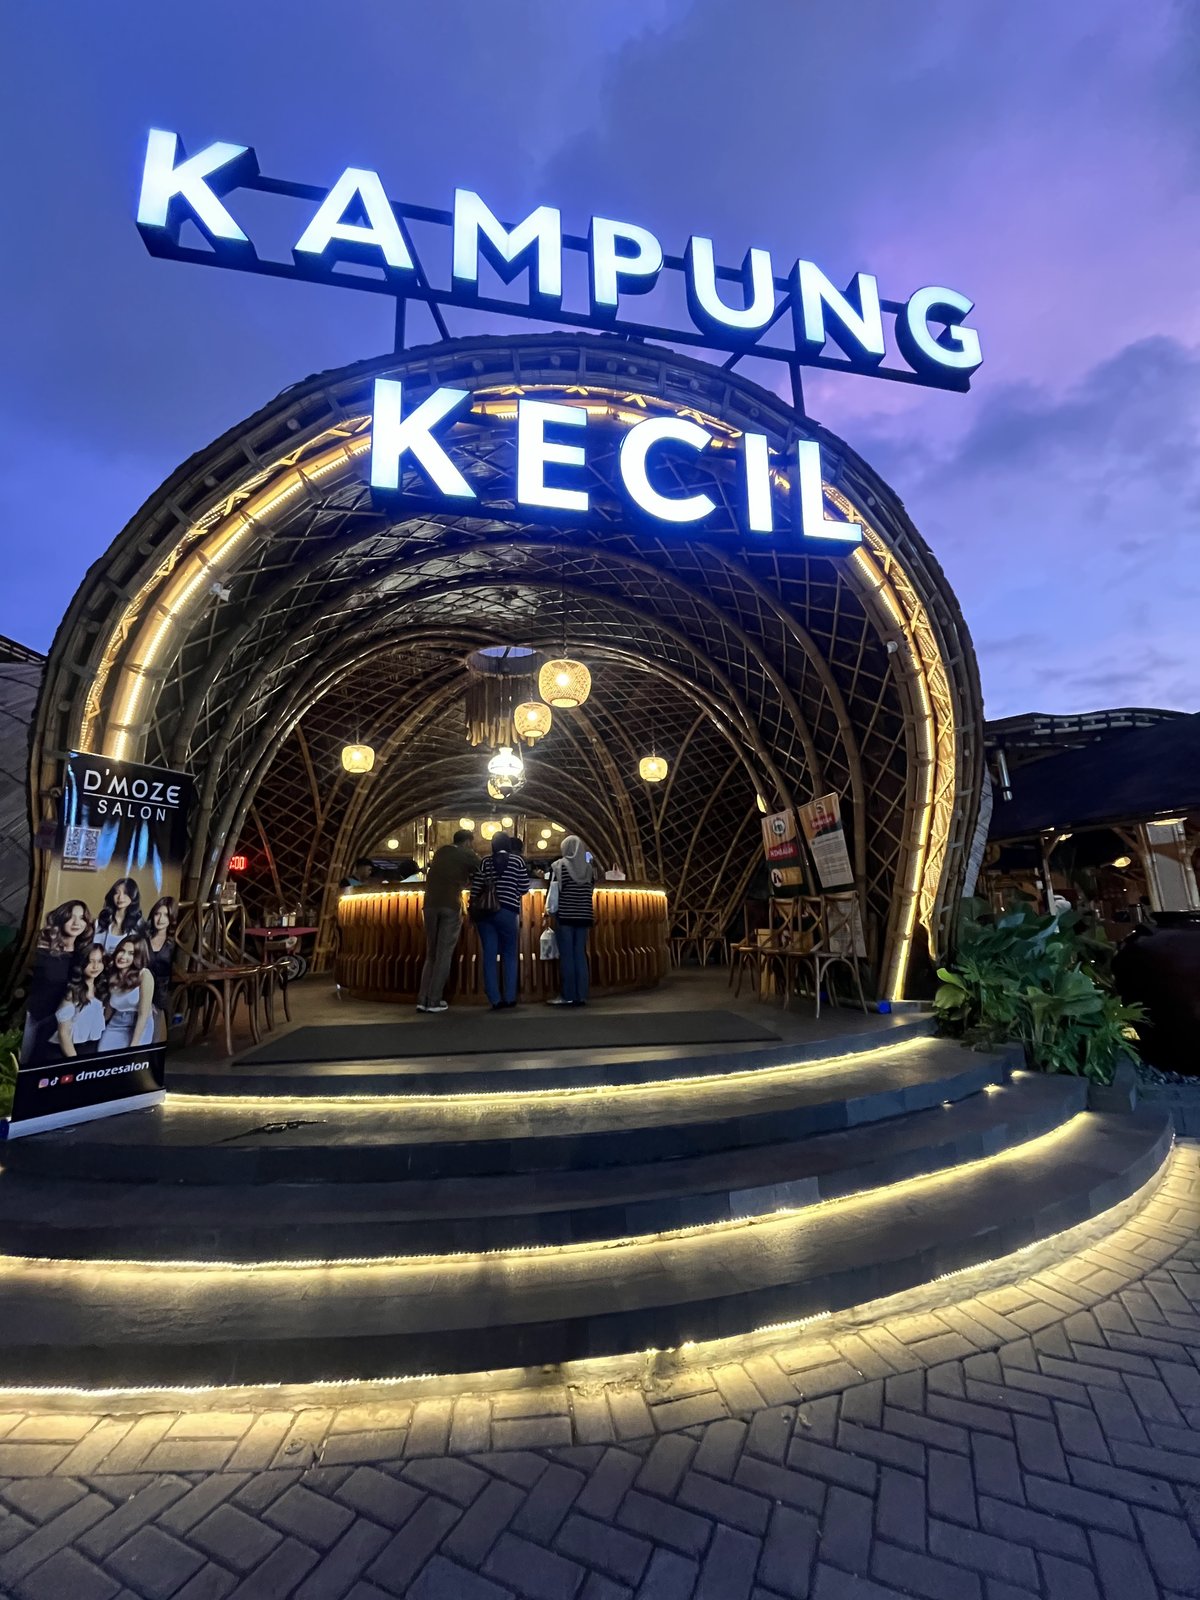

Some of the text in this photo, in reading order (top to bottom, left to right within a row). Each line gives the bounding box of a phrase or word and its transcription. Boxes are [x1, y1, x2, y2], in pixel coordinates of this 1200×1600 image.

[136, 127, 982, 370] KAMPUNG
[371, 379, 864, 542] KECIL
[83, 769, 181, 803] D'MOZE
[97, 799, 166, 821] SALON
[76, 1060, 149, 1081] dmozesalon
